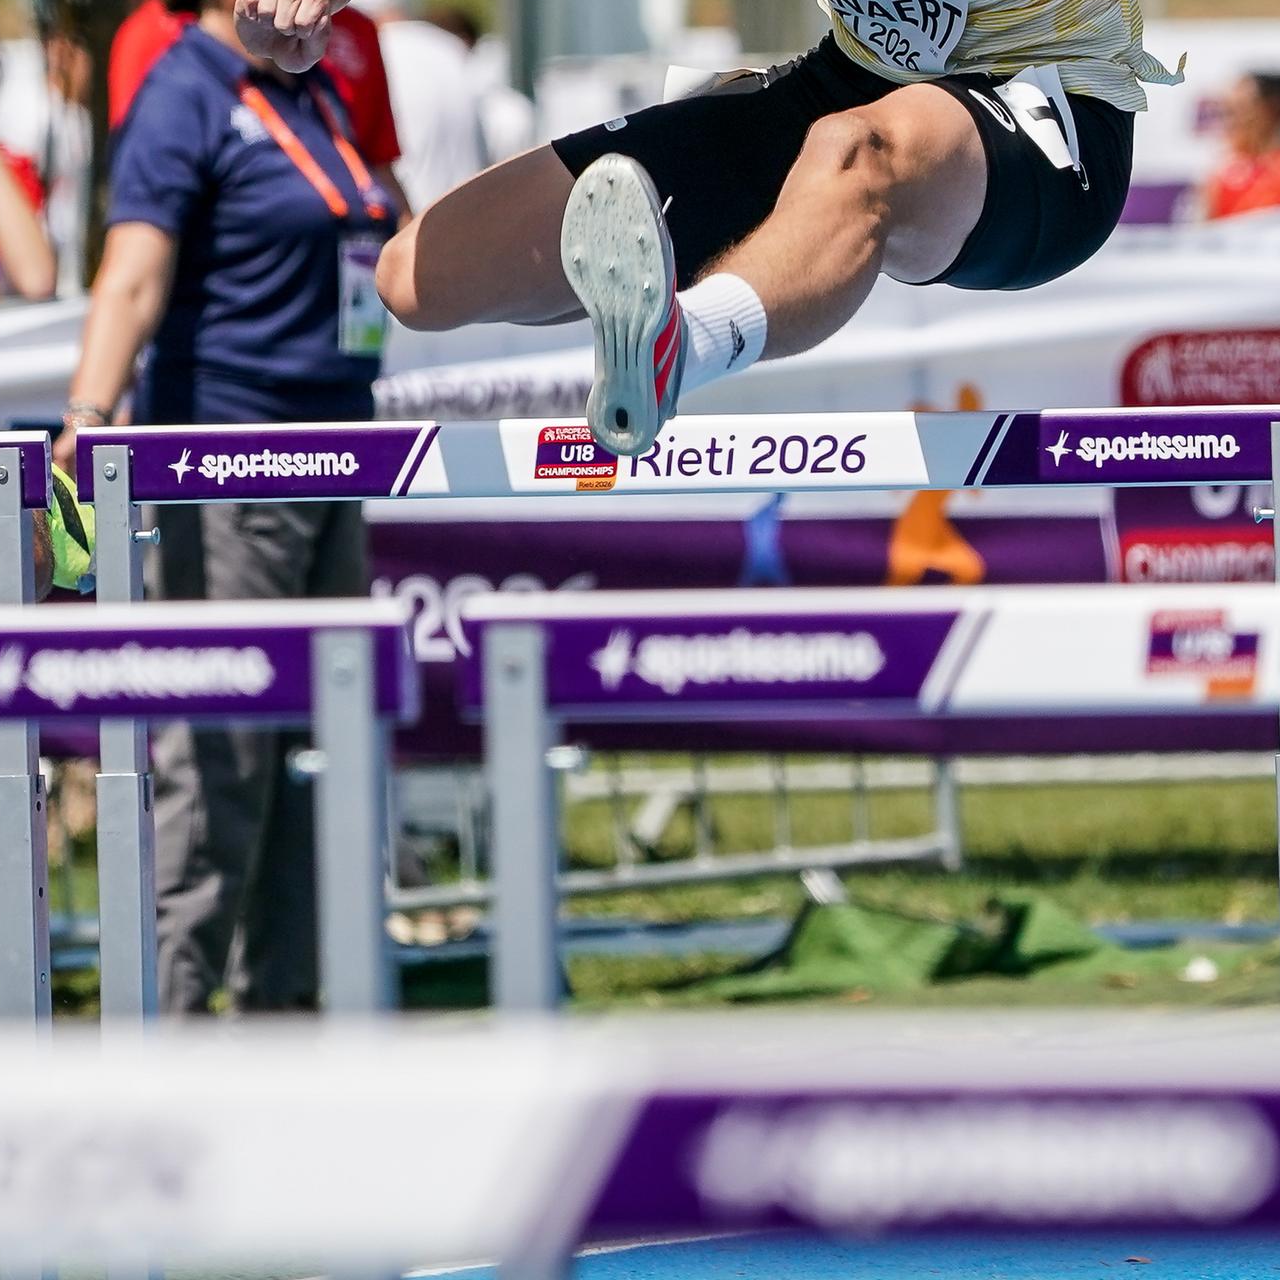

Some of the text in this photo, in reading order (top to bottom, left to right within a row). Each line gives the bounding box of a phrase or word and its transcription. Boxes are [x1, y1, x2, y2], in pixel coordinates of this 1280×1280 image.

[869, 22, 921, 70] 2026
[197, 449, 360, 486] sportissimo
[561, 444, 595, 462] U18
[630, 434, 867, 478] Rieti 2026
[1075, 432, 1241, 469] sportissimo
[538, 466, 614, 476] CHAMPIONSHIPS
